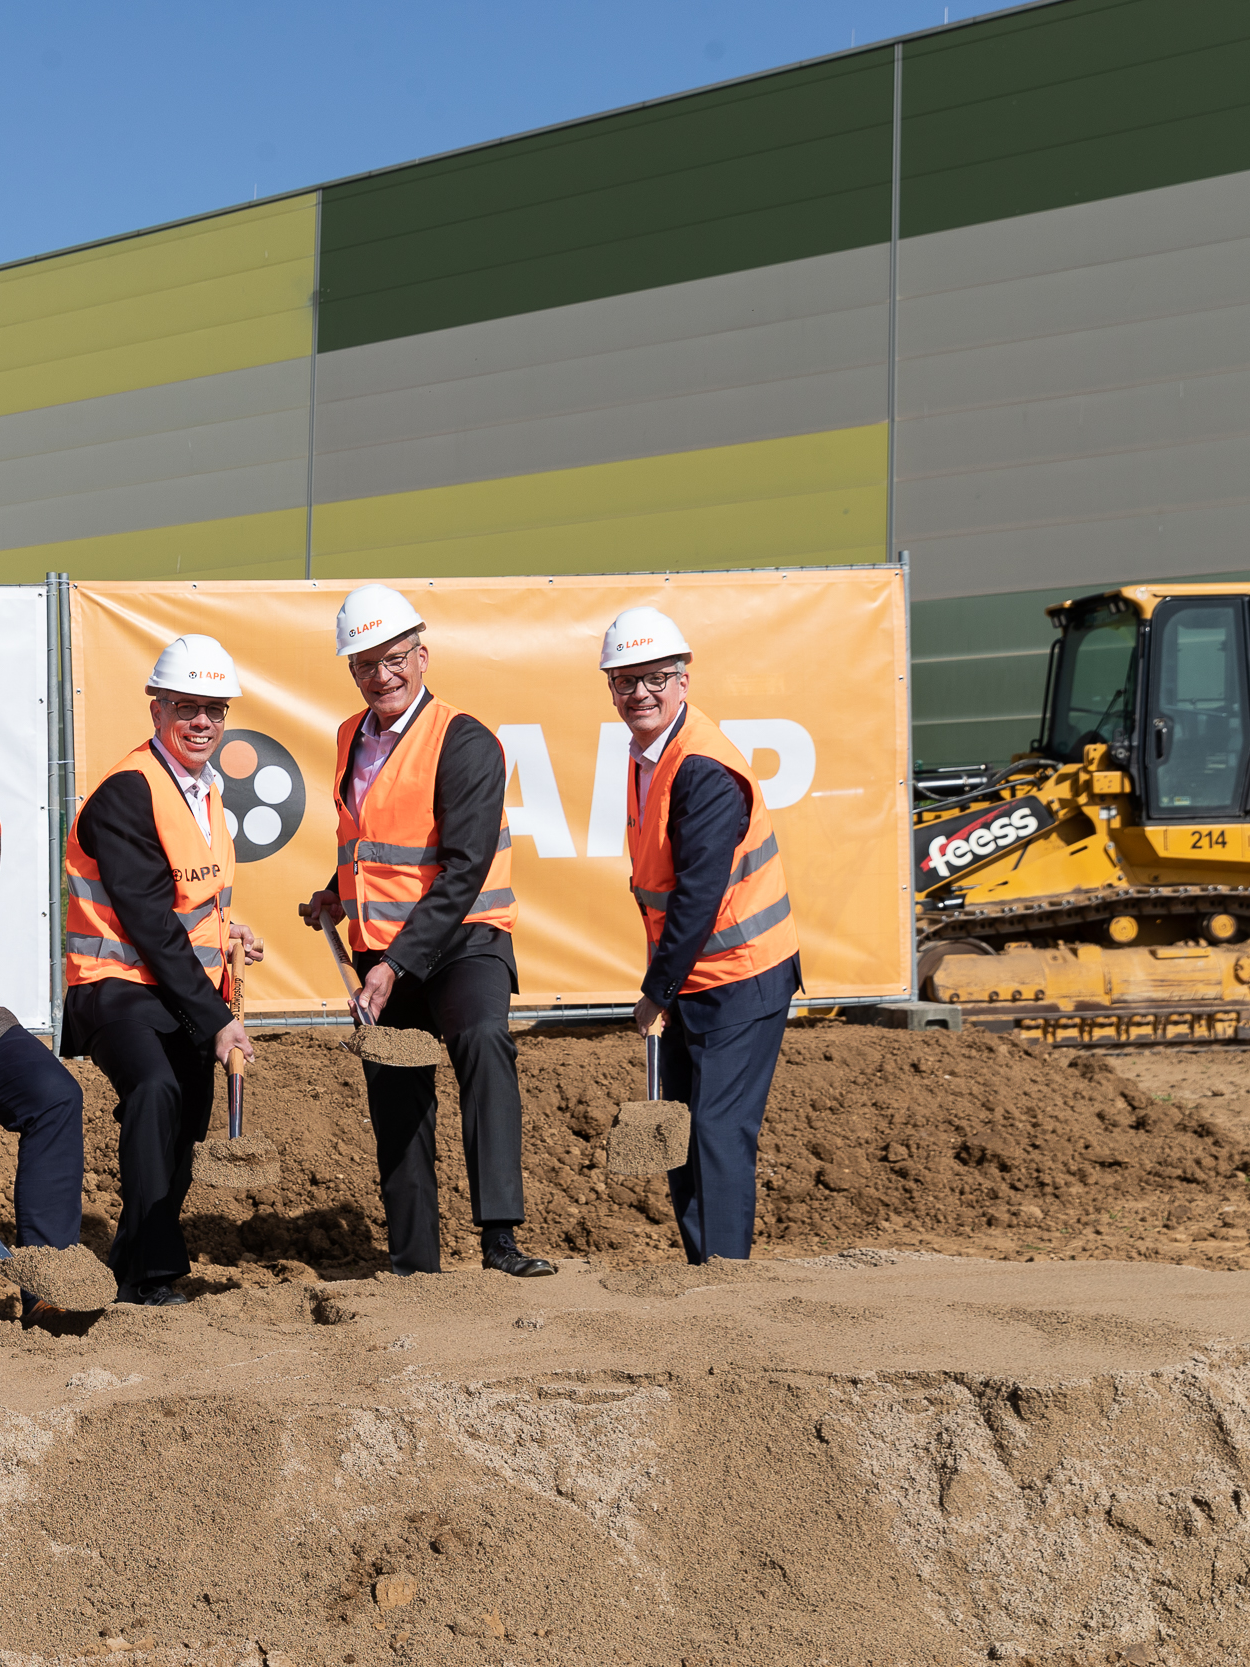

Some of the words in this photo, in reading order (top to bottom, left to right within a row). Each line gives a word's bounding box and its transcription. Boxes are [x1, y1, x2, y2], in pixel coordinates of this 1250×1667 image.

[356, 619, 383, 635] LAPP
[626, 637, 654, 649] LAPP
[199, 671, 226, 681] LAPP
[928, 807, 1038, 877] feess
[1191, 830, 1227, 849] 214
[185, 864, 221, 882] LAPP
